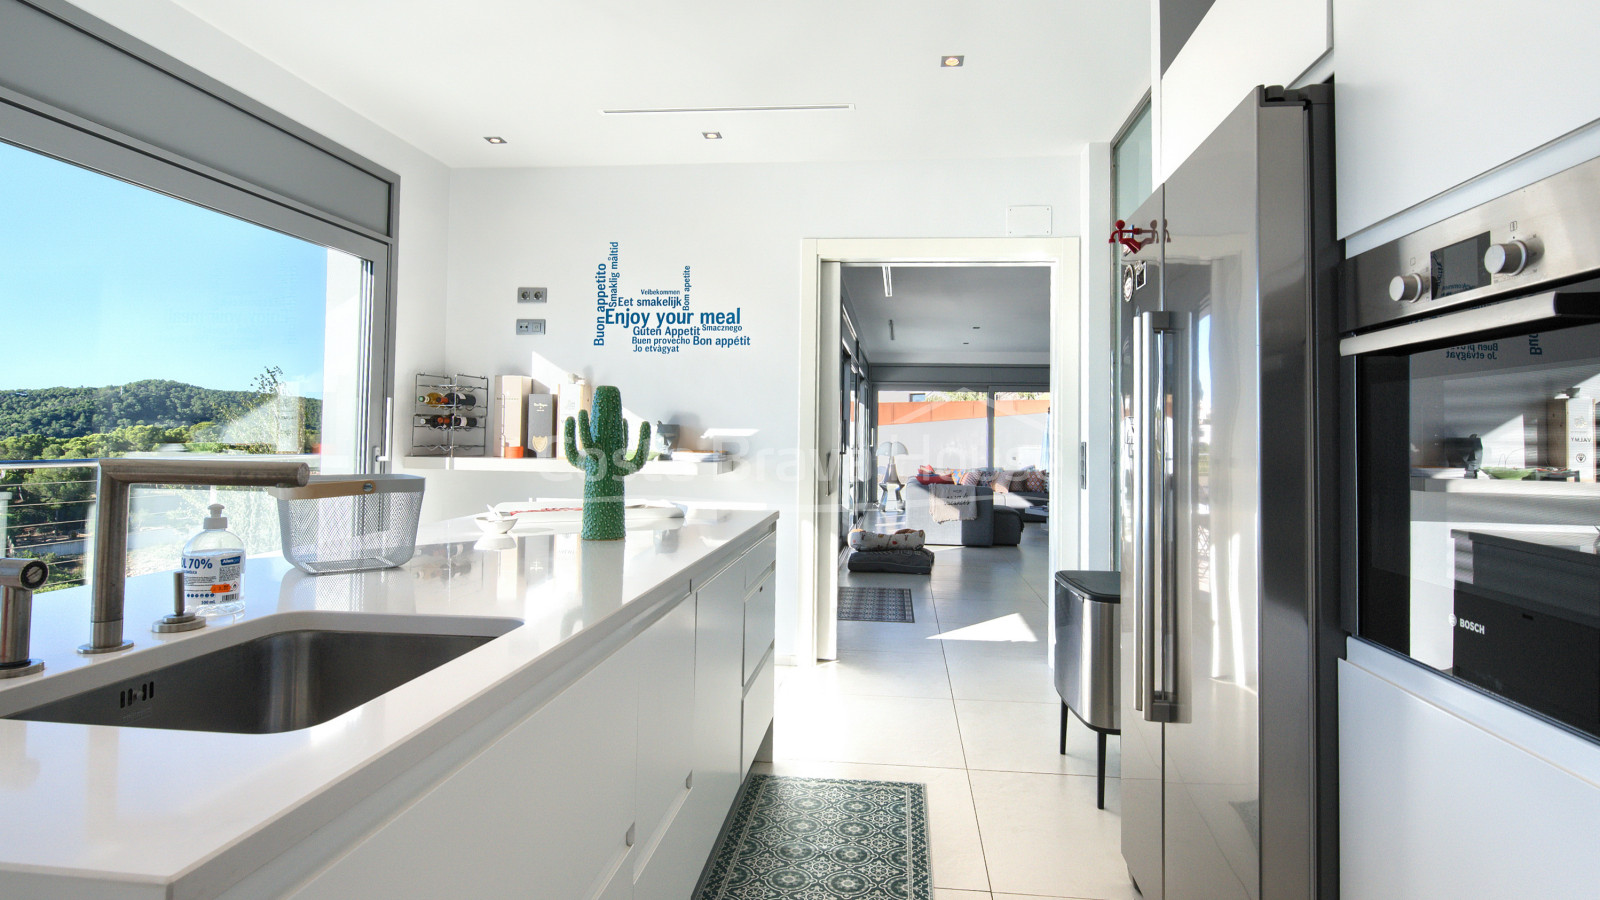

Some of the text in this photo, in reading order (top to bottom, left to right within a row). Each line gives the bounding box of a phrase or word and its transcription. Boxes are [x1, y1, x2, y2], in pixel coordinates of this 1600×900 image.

[607, 241, 621, 308] Smaklig måltid
[682, 265, 692, 312] Bom apetite
[594, 263, 609, 347] Buon appetito
[618, 295, 682, 309] Eet smakelijk
[605, 307, 741, 329] Enjoy your meal
[632, 325, 701, 339] Guten Appetit
[701, 324, 743, 334] Smacznego
[631, 336, 691, 348] Buen provecho
[632, 345, 643, 353] Jo
[693, 335, 751, 349] Bon appétit
[189, 558, 213, 569] 70%
[1459, 618, 1485, 635] BOSCH
